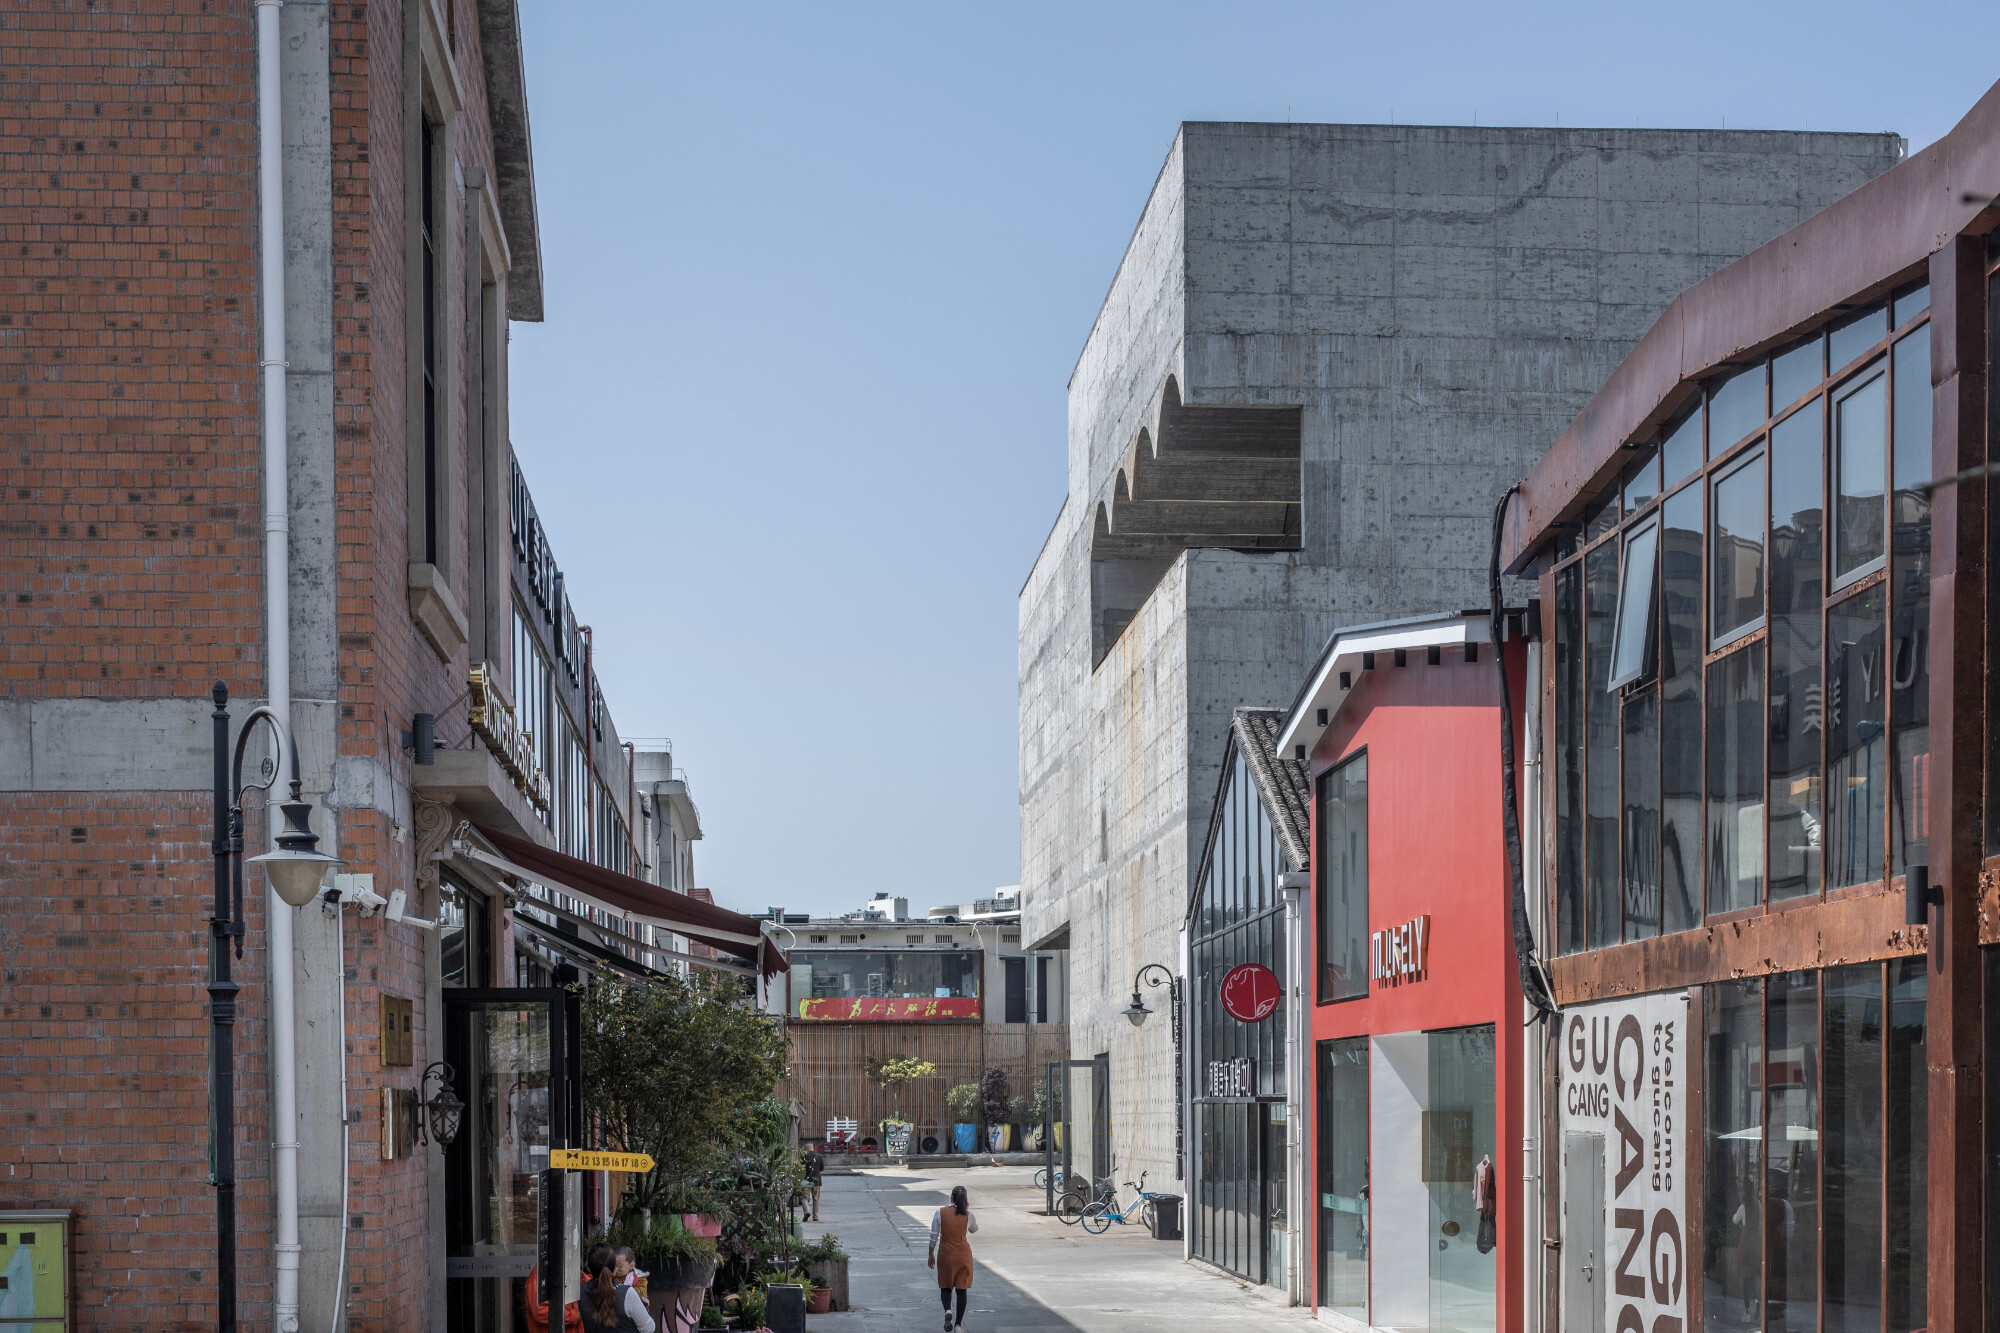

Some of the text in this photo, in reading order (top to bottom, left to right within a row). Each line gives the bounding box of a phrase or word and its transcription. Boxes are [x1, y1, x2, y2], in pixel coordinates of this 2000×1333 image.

[1568, 1014, 1609, 1075] GU
[1568, 1082, 1609, 1119] CANG
[1651, 1021, 1662, 1193] to gucang
[1664, 1020, 1675, 1193] Welcome
[581, 1155, 589, 1166] 12
[592, 1156, 600, 1167] 13
[602, 1156, 610, 1167] 15
[611, 1157, 619, 1167] 16
[621, 1158, 629, 1168] 17
[631, 1158, 639, 1168] 18
